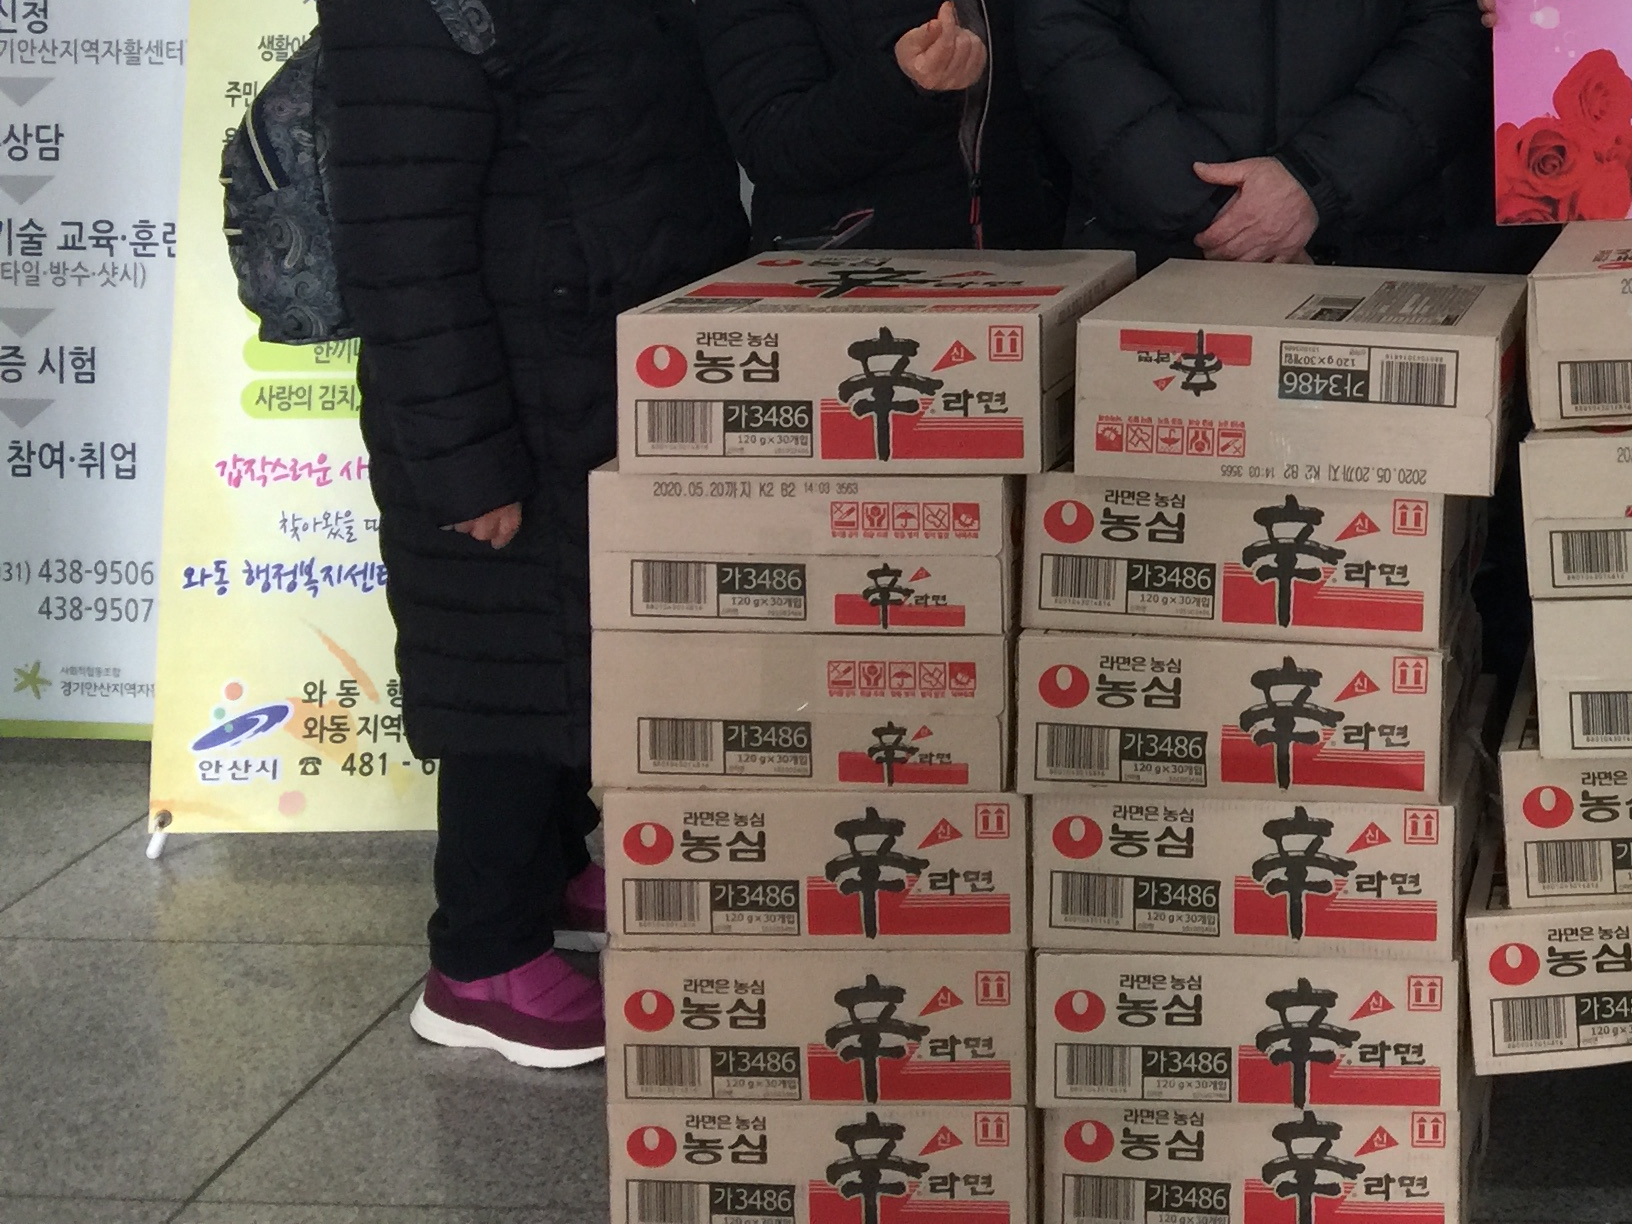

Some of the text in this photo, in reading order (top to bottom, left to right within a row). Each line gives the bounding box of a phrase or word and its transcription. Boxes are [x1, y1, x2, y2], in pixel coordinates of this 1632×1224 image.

[695, 331, 744, 348] 라면은
[37, 345, 96, 385] 시험
[255, 384, 313, 412] 사랑의
[837, 325, 1009, 462] 辛 라면
[738, 434, 757, 444] 120
[214, 452, 334, 489] 갑작스러운
[1154, 492, 1186, 509] 농심
[37, 558, 154, 585] 438-9506
[1241, 493, 1347, 629] 辛
[182, 559, 230, 596] 와동
[1131, 563, 1212, 590] 가3486
[37, 595, 154, 623] 438-9507
[1095, 673, 1182, 710] 농심
[302, 714, 351, 744] 와동
[198, 751, 387, 781] 안산시 481
[679, 829, 767, 864] 농심
[680, 996, 767, 1031] 농심
[715, 1050, 797, 1074] 가3486
[682, 1131, 768, 1166] 농심
